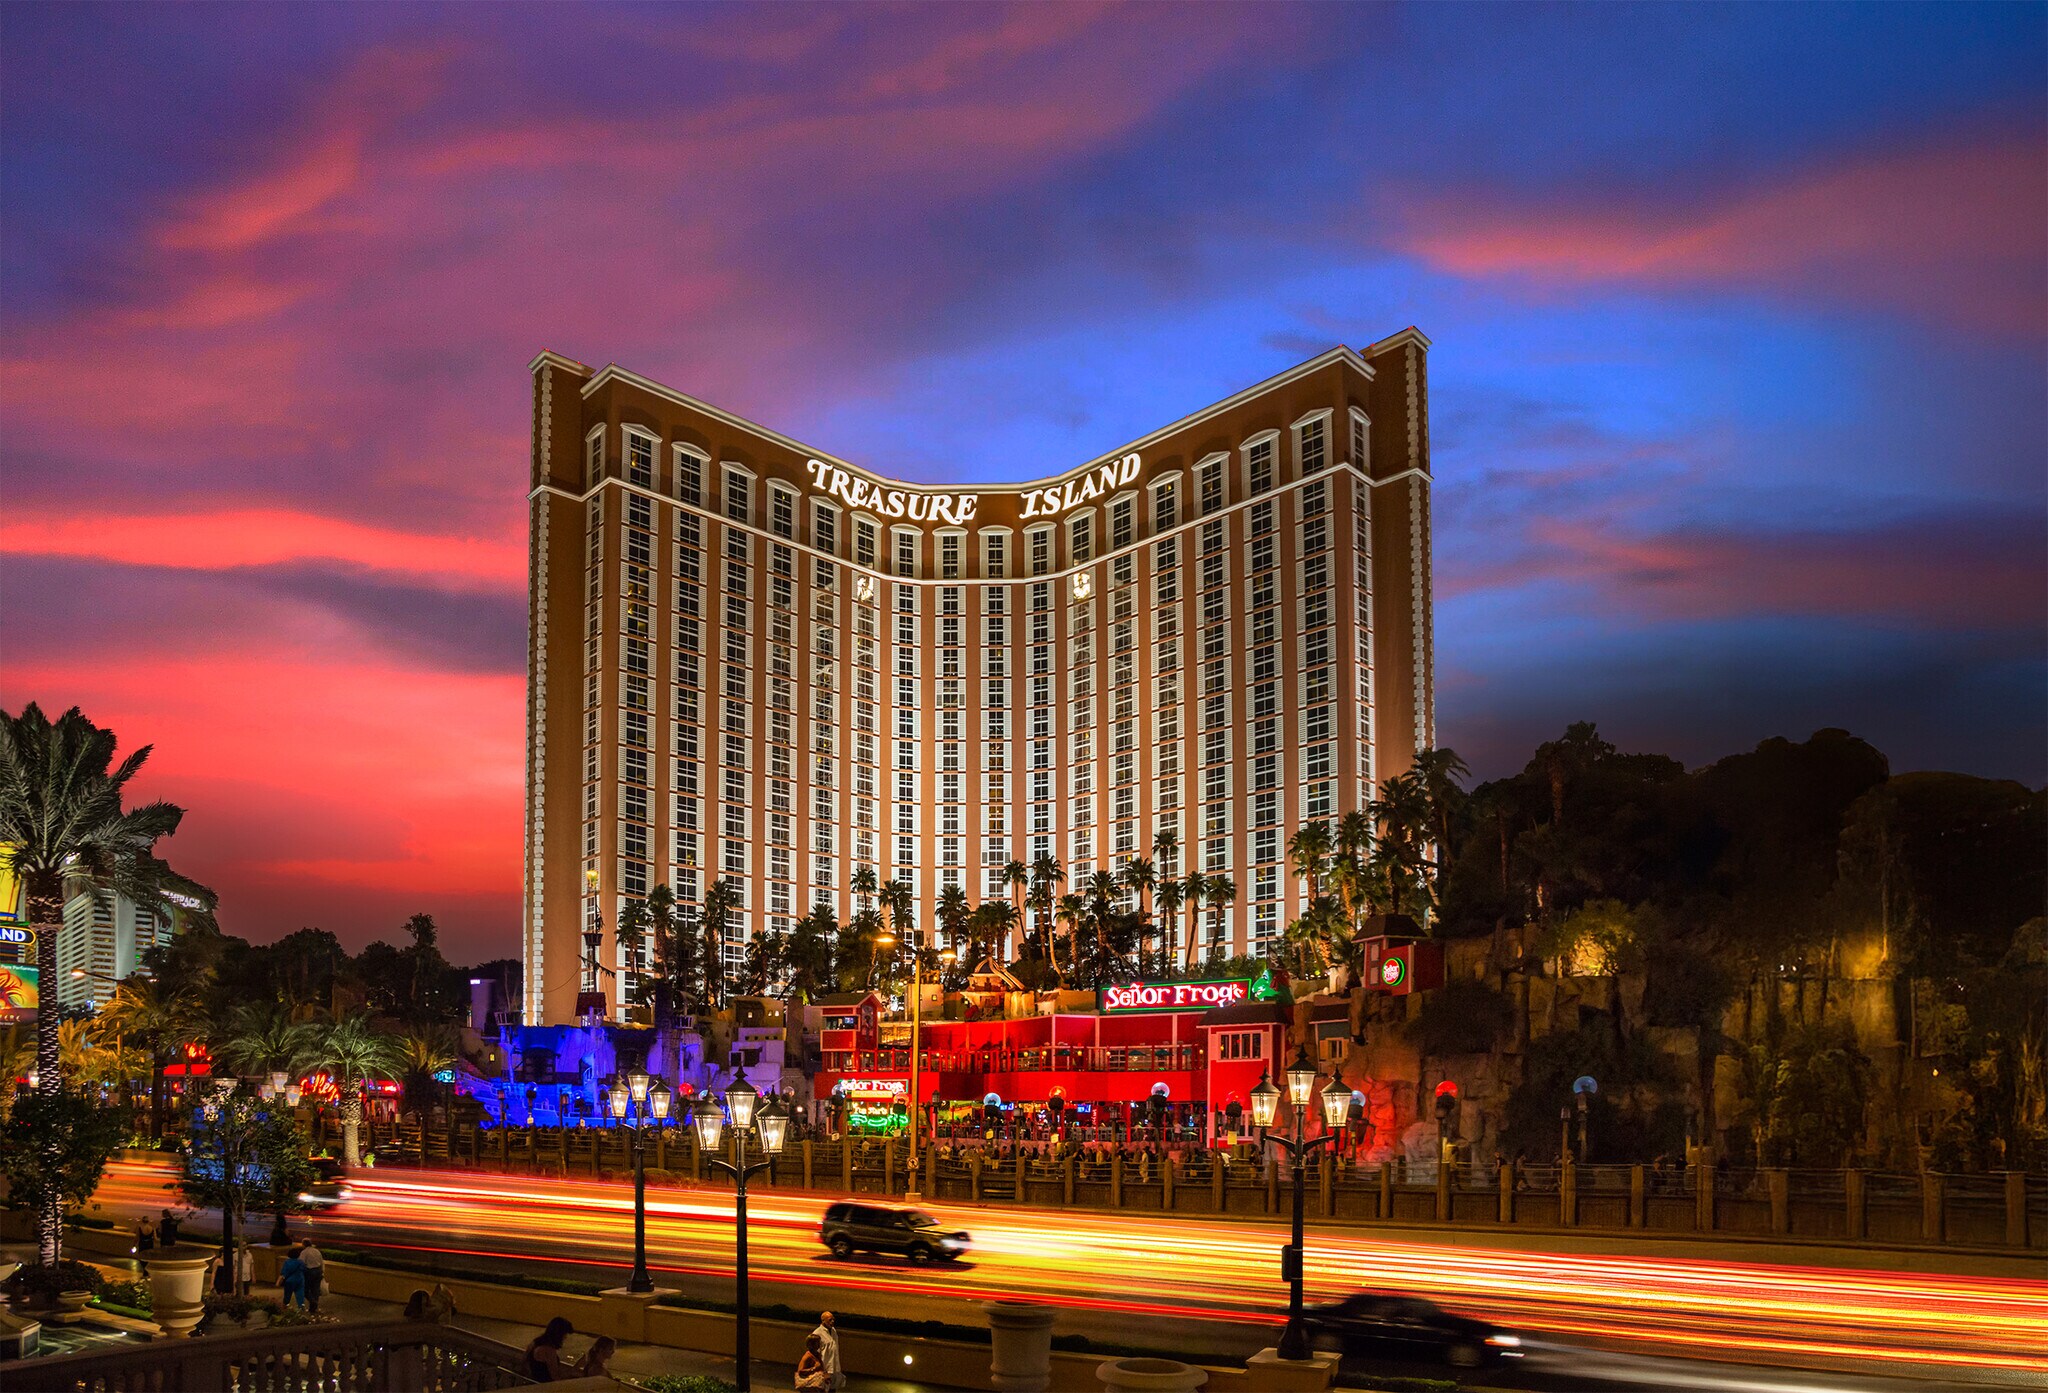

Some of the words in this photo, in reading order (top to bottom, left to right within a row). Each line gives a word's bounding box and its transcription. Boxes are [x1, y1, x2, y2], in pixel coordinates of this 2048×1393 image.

[806, 459, 978, 525] TREASURE
[1019, 453, 1141, 519] ISLAND
[0, 928, 26, 942] ND
[1106, 982, 1170, 1010] Señor
[1173, 983, 1244, 1008] Frog's
